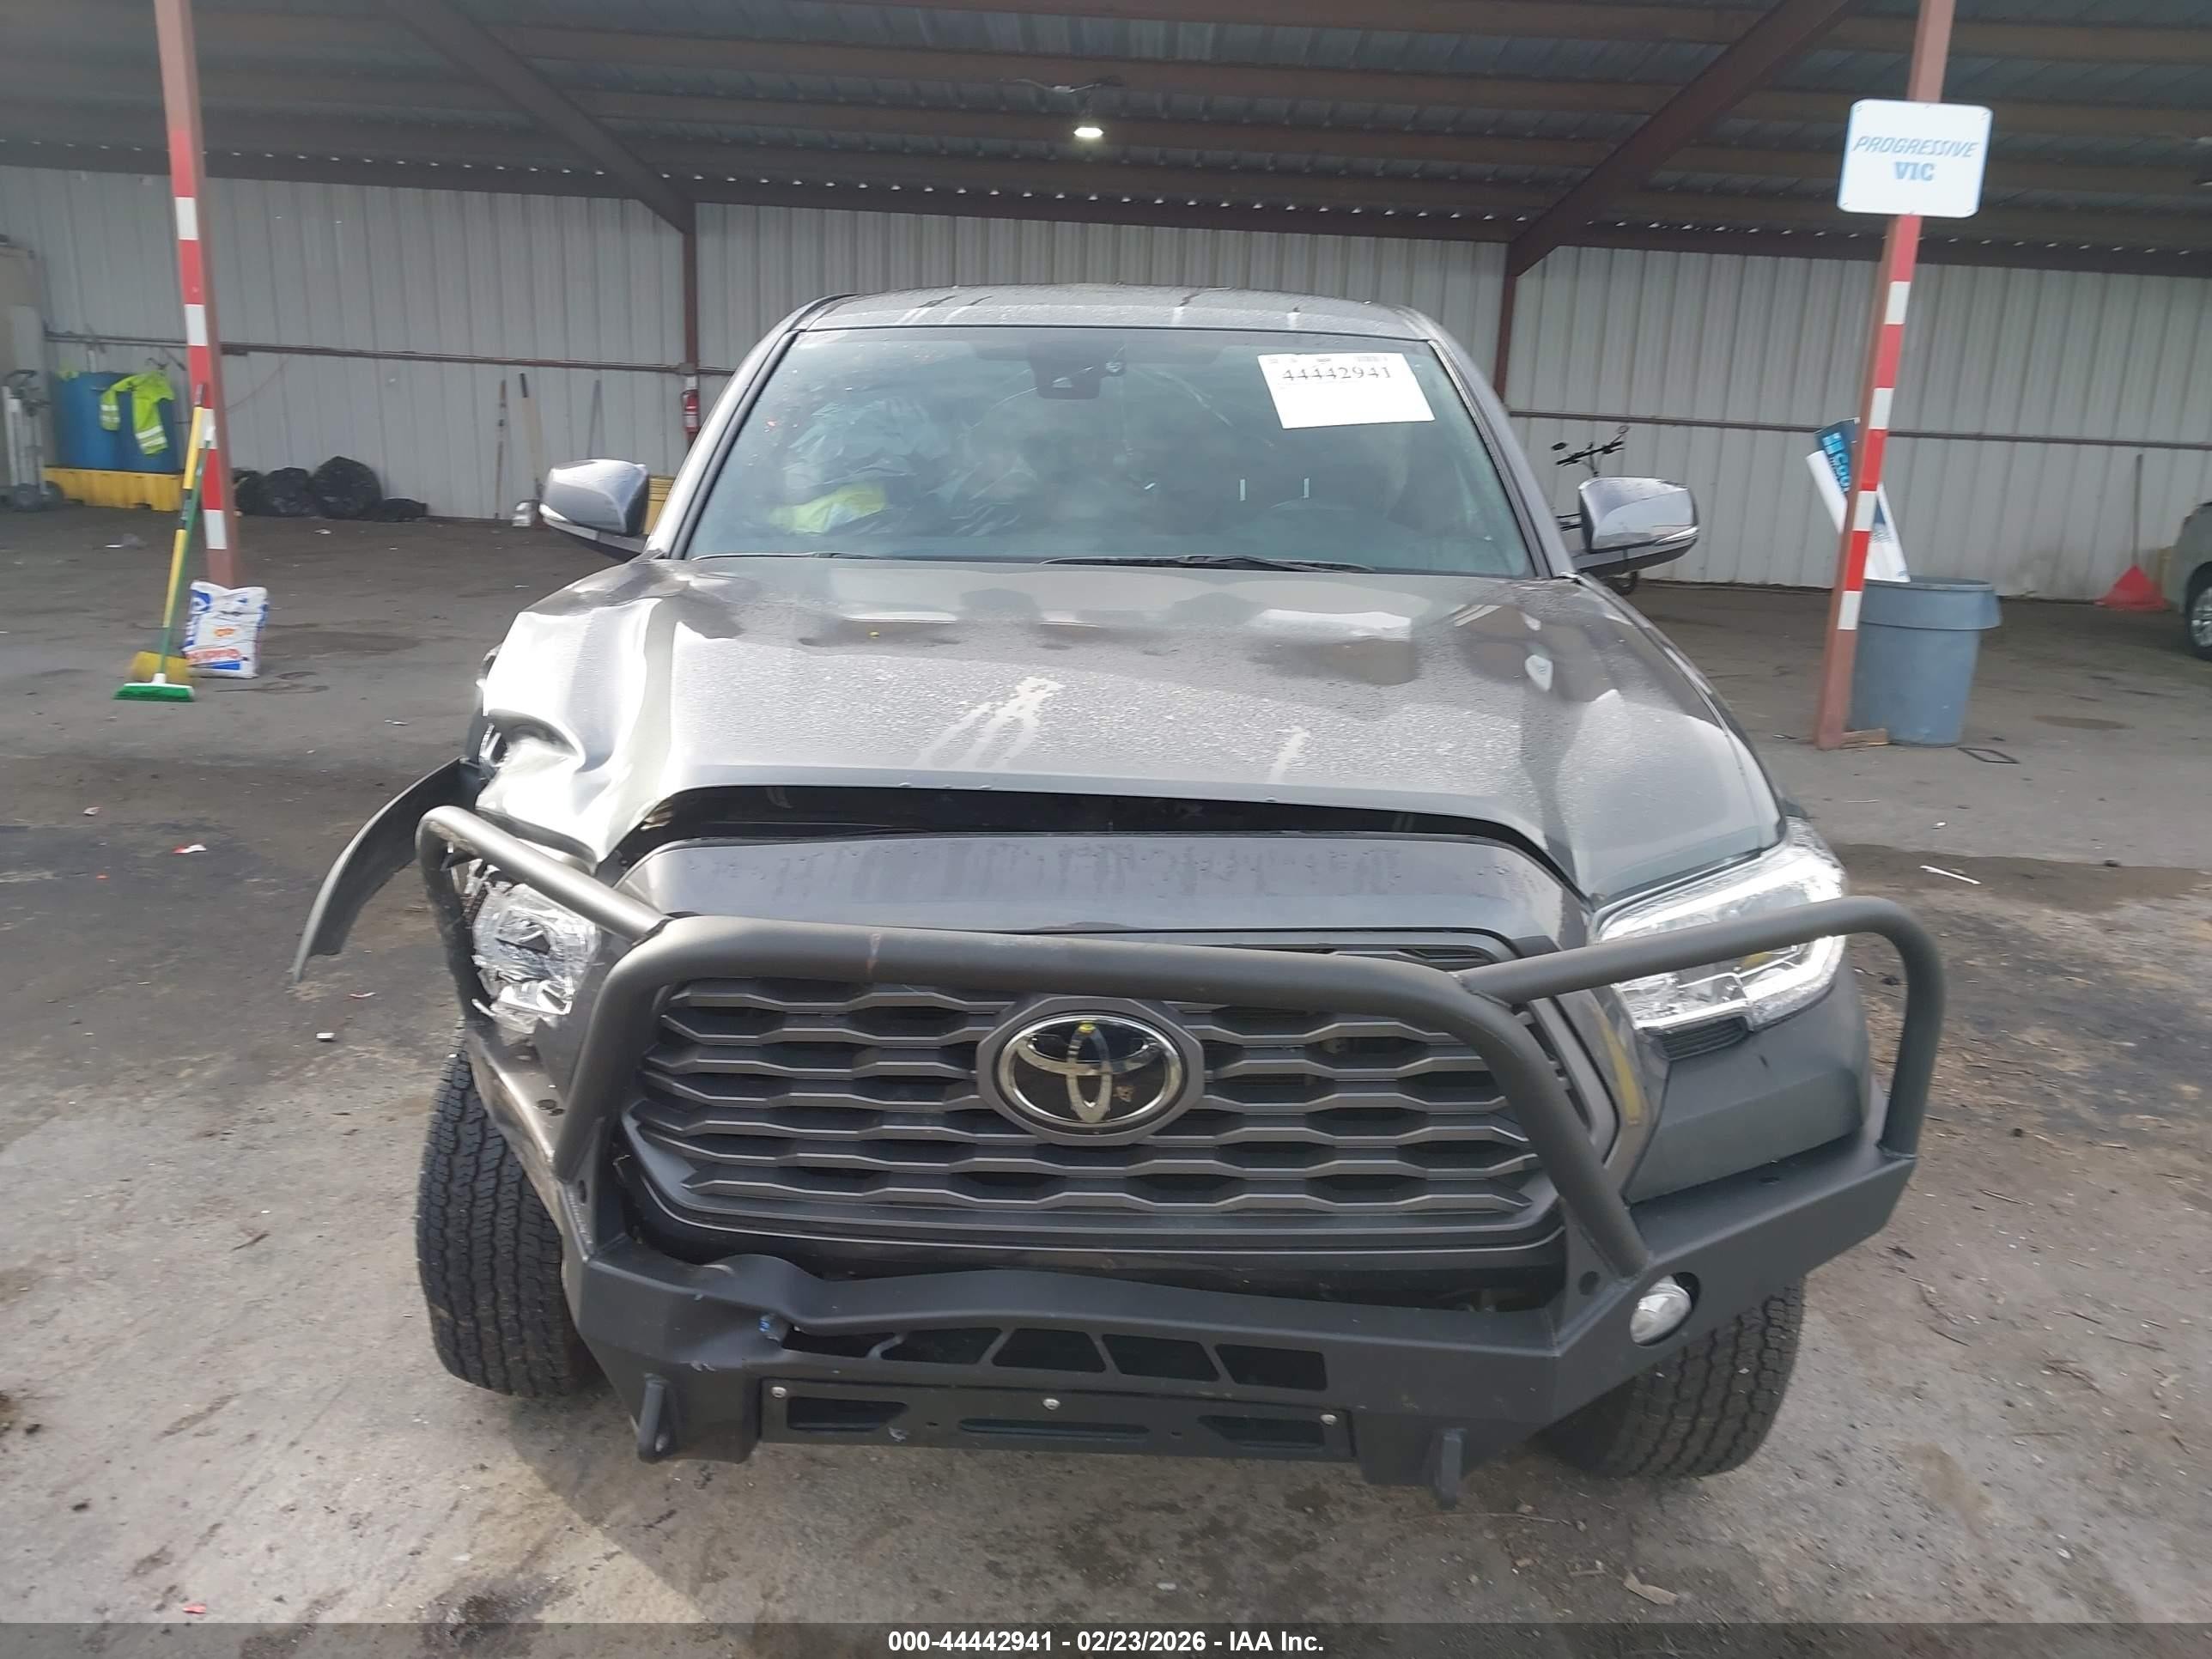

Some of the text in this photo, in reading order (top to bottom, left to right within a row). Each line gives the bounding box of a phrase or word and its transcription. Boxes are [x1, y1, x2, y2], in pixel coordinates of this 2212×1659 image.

[1852, 136, 1978, 157] PROGRESSIVE
[1894, 161, 1936, 180] VIC
[1282, 367, 1392, 380] 44442941
